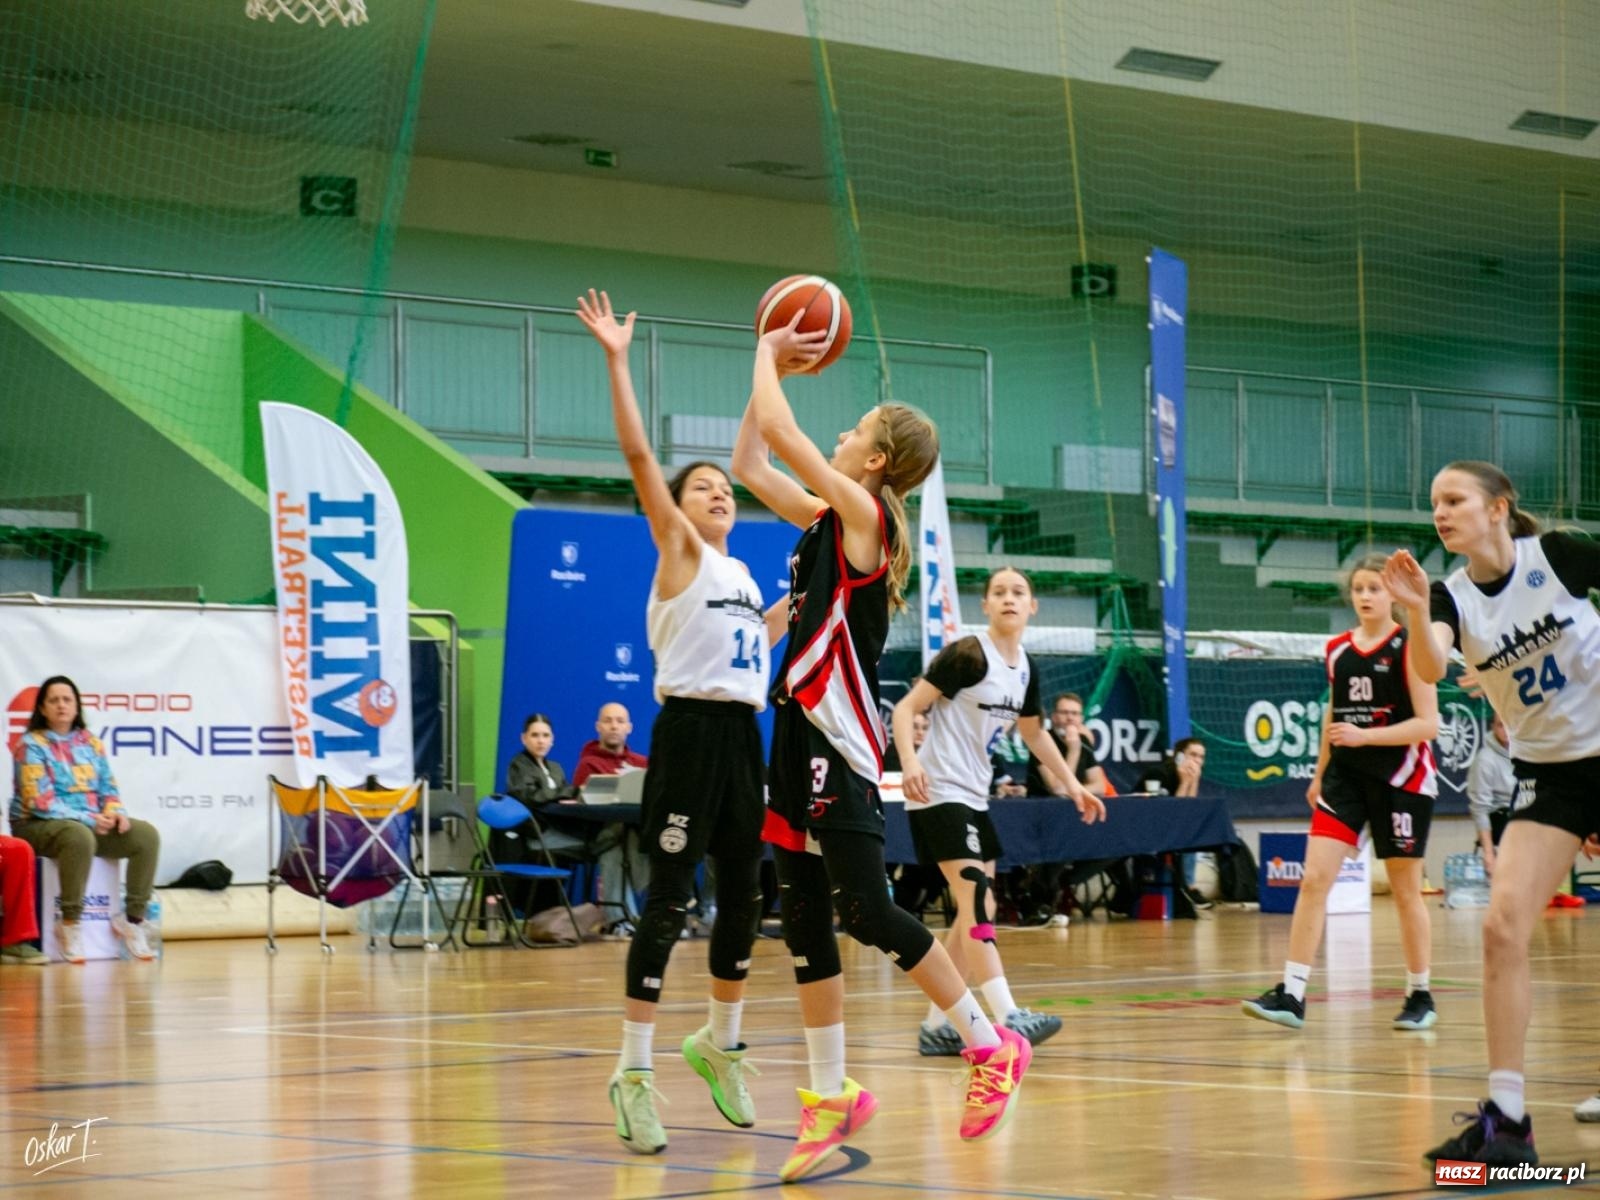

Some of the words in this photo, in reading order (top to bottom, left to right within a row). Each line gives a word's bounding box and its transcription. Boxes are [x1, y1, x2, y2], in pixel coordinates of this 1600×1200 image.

[730, 628, 763, 674] 14
[1490, 625, 1563, 672] WARSAW
[1348, 676, 1374, 702] 20
[1512, 653, 1568, 708] 24
[79, 693, 193, 712] RADIO
[1245, 700, 1328, 758] OSi
[810, 756, 829, 794] 3
[157, 795, 213, 809] 100.3
[221, 795, 255, 809] FM
[1391, 811, 1413, 837] 20
